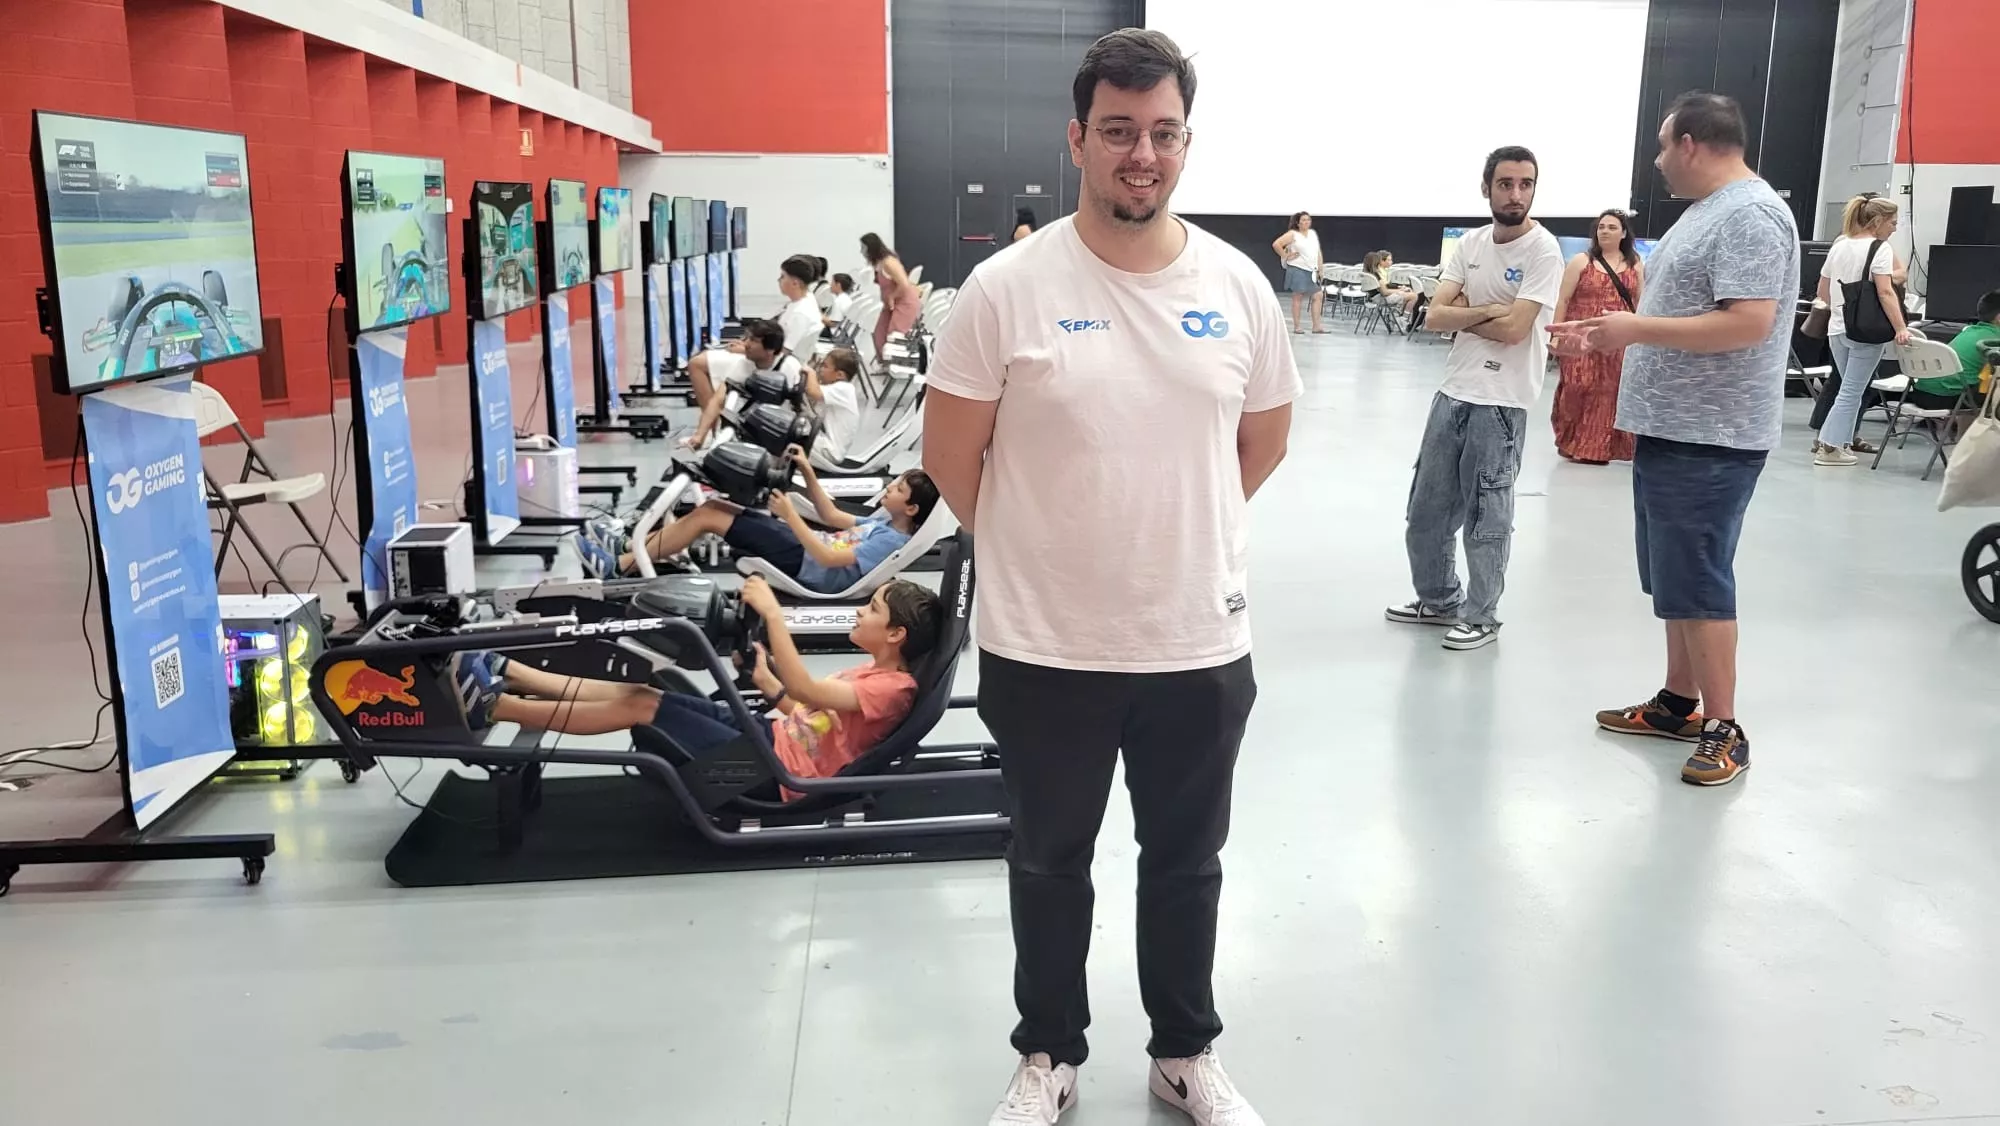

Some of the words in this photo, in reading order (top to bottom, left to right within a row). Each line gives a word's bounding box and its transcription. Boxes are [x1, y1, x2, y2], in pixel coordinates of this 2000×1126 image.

[144, 453, 184, 479] OXYGEN
[144, 469, 186, 496] GAMING
[359, 711, 391, 726] Red
[393, 711, 425, 726] Bull
